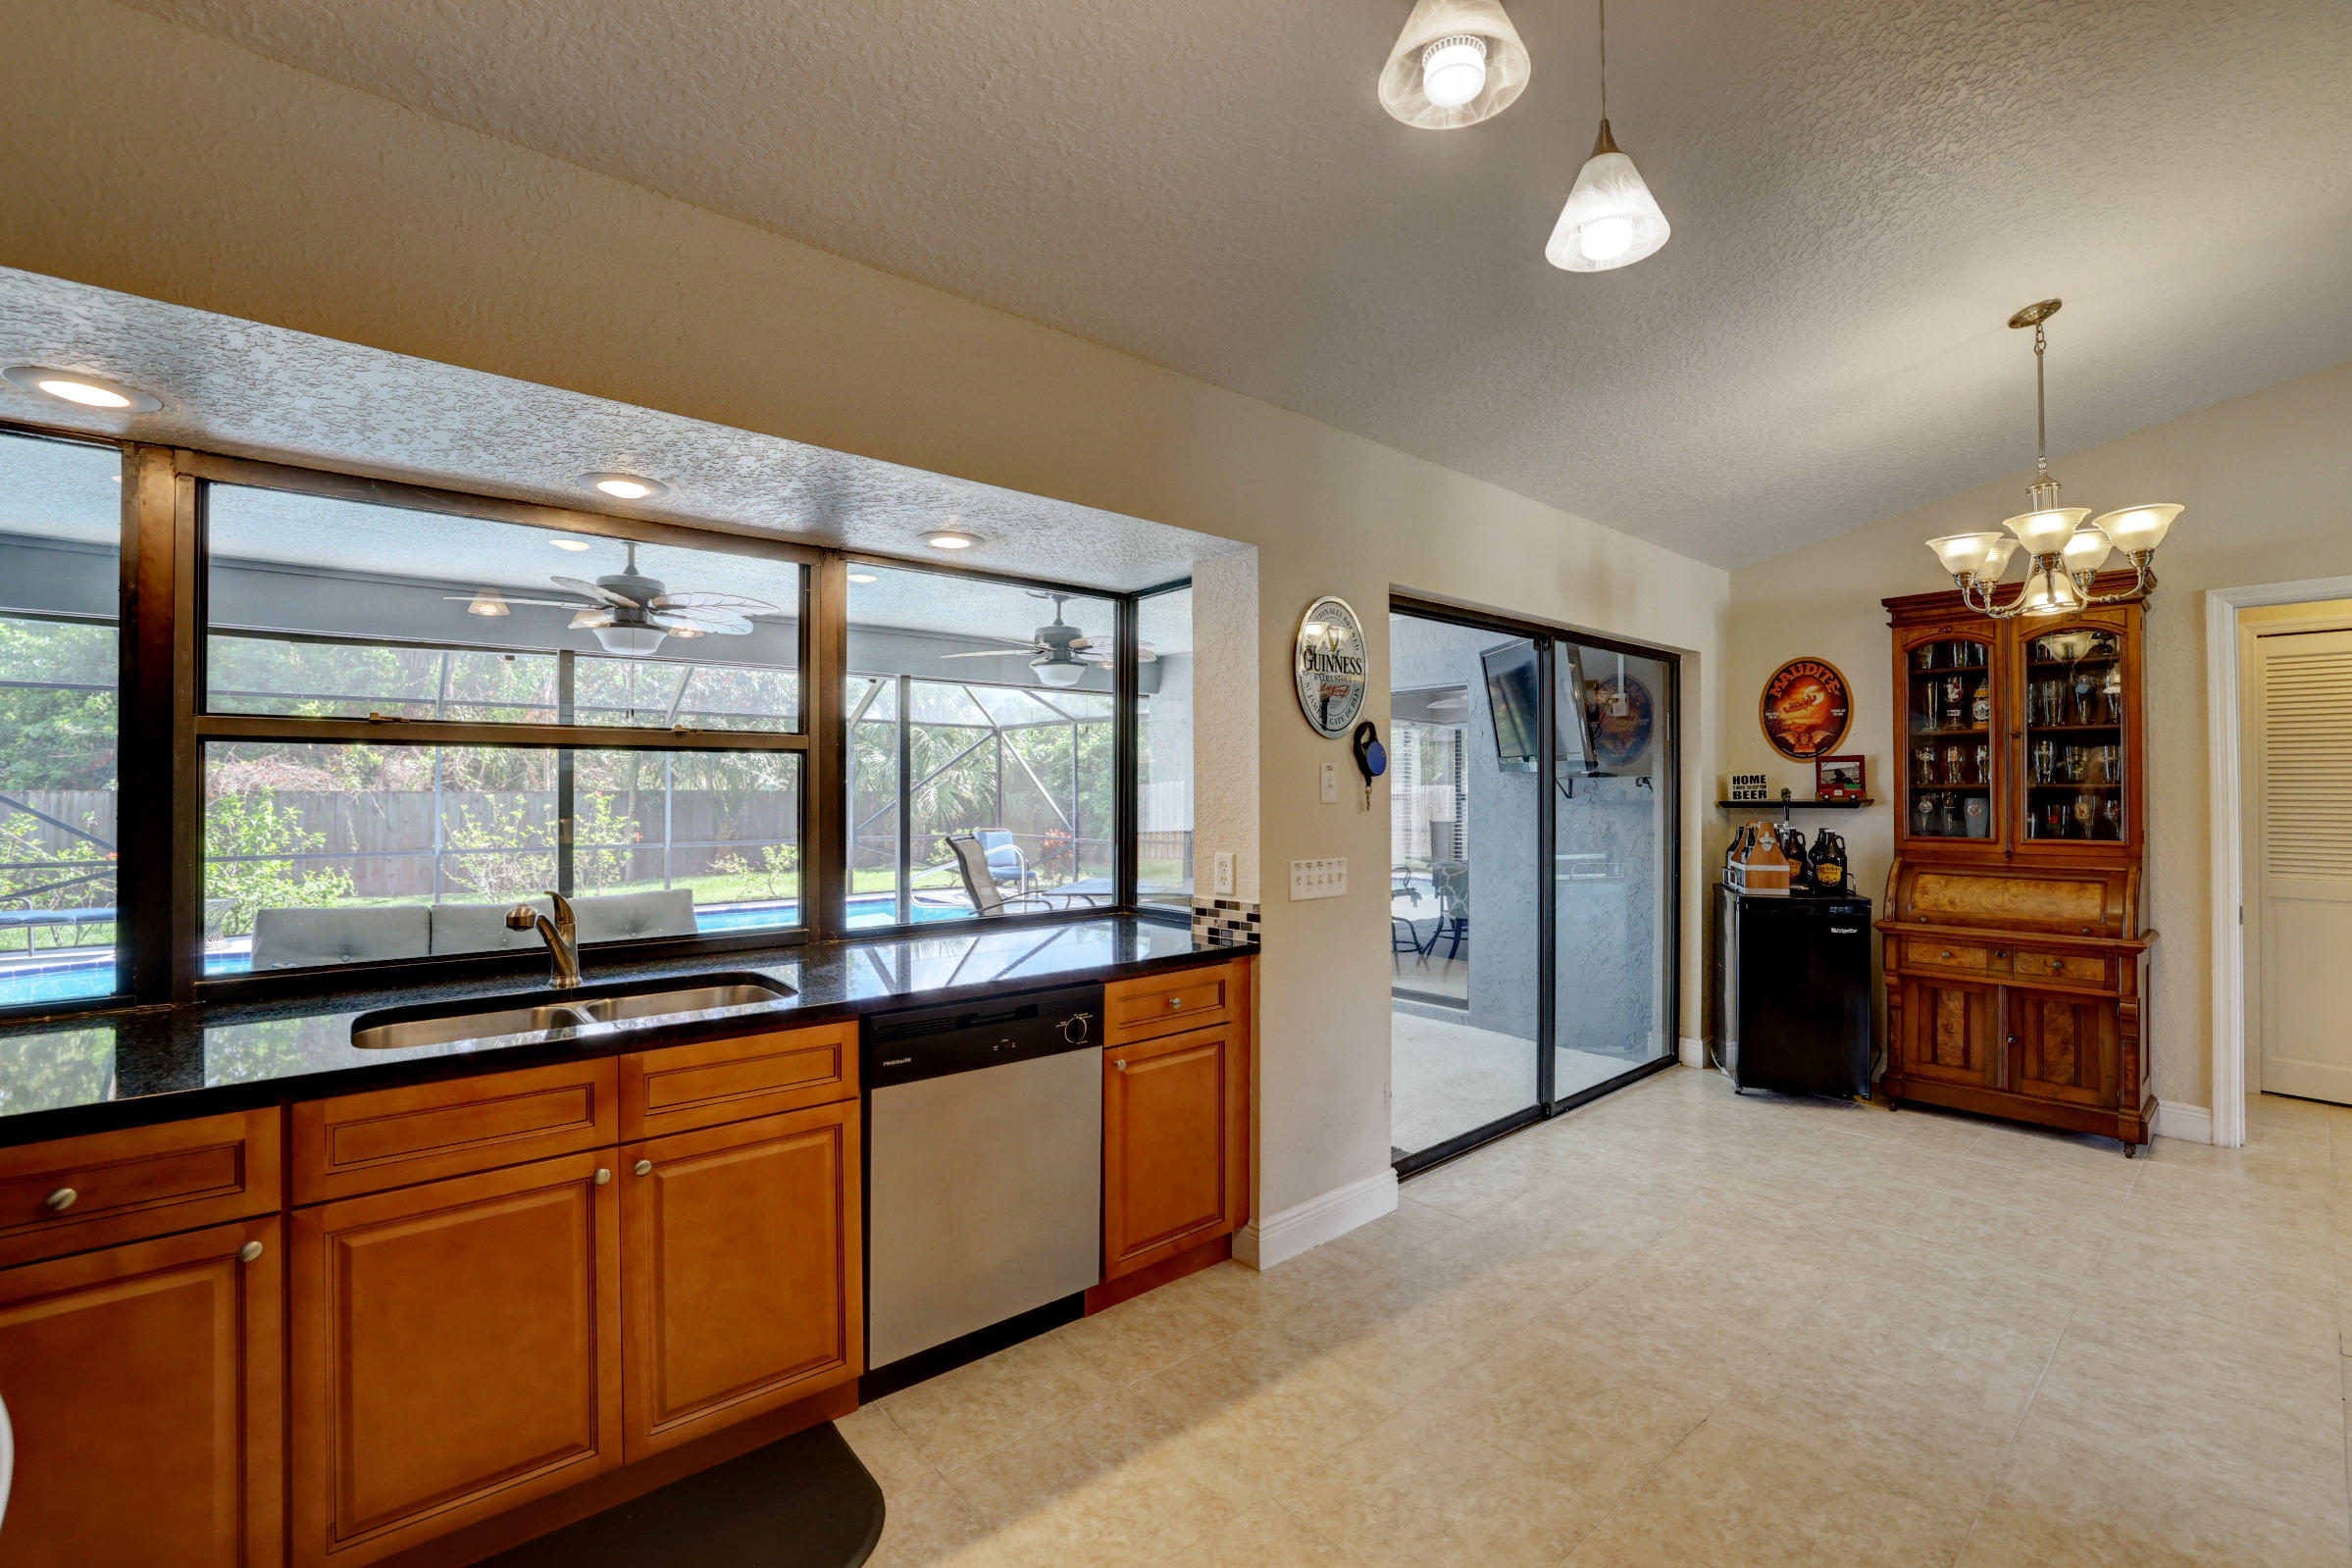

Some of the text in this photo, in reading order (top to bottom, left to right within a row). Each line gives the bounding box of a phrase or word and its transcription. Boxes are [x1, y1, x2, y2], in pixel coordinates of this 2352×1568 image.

[1304, 649, 1362, 675] GUINNESS
[1334, 675, 1353, 683] STOUT
[1769, 663, 1841, 698] MAUDITE
[1329, 713, 1346, 725] GATE
[1345, 687, 1360, 718] DUBLIN
[1732, 775, 1766, 784] HOME
[1732, 790, 1767, 800] BEER
